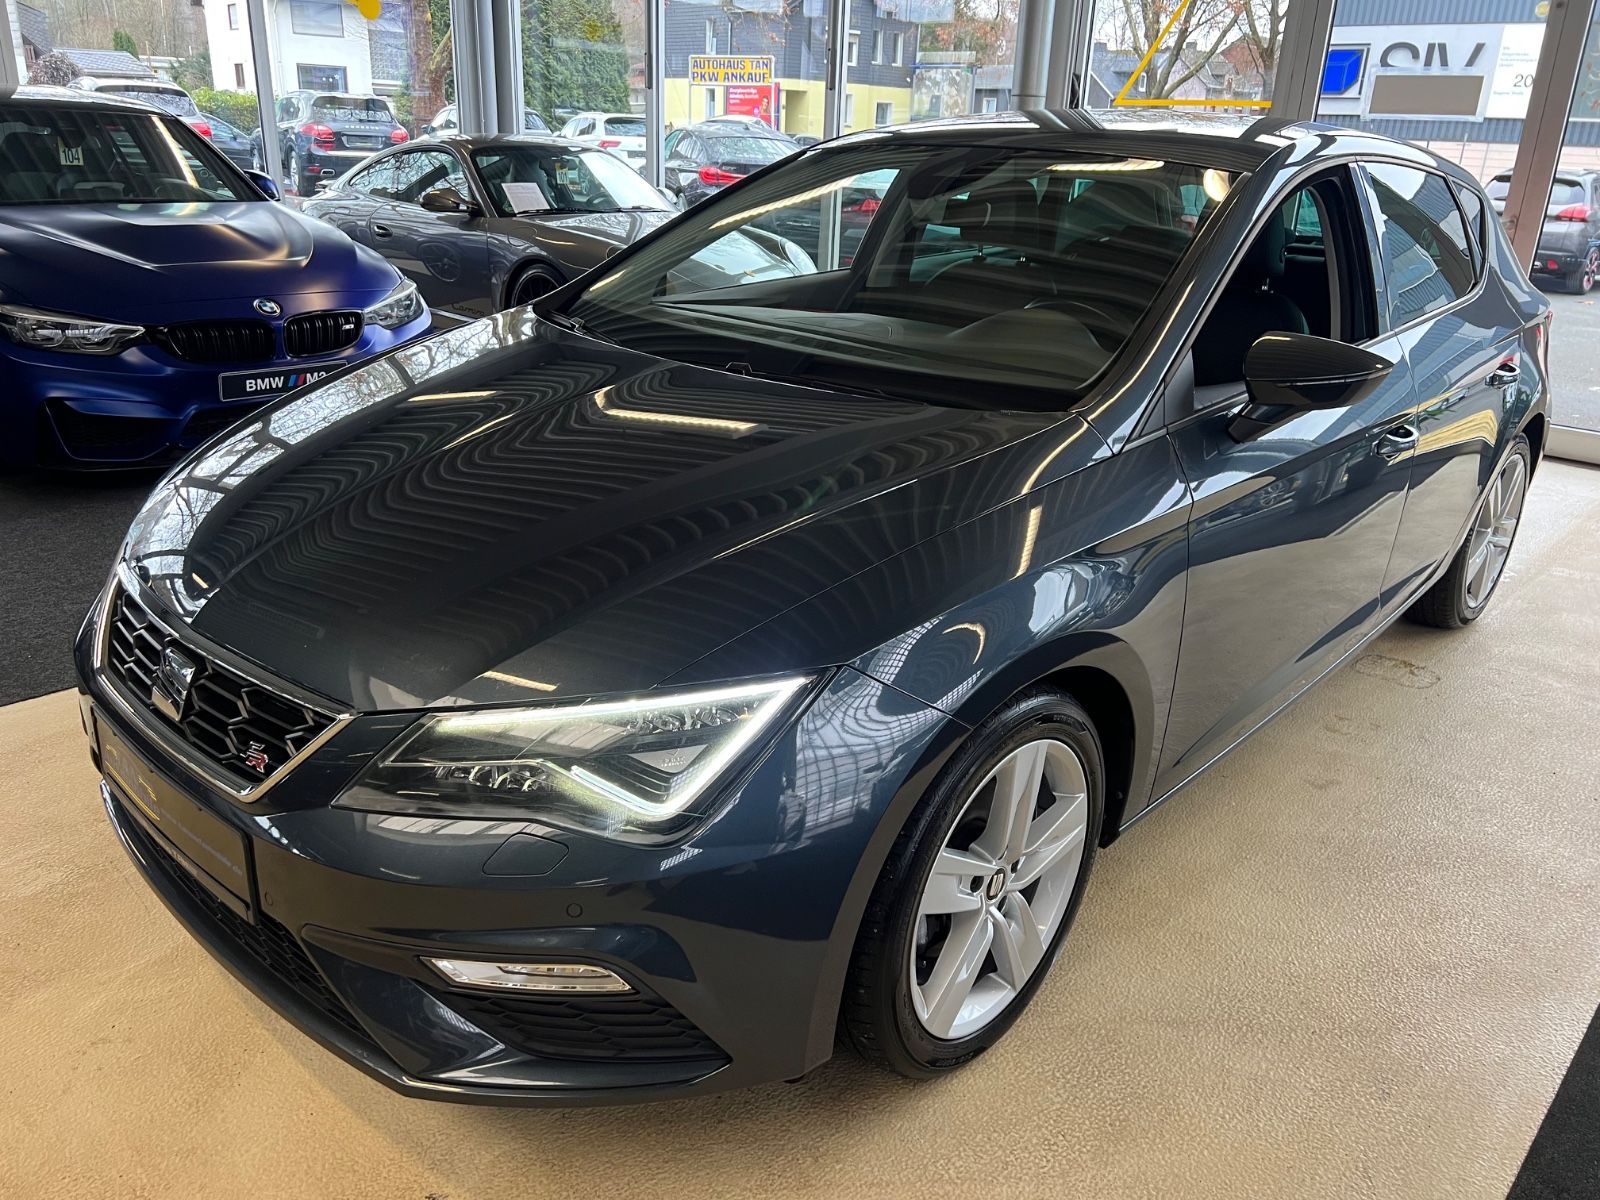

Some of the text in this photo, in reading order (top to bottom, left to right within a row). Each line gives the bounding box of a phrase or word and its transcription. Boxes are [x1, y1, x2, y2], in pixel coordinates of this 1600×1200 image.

[692, 60, 769, 70] AUTOHAUS TAN
[692, 72, 769, 82] PKW ANKAUF
[62, 148, 81, 164] 104
[246, 376, 284, 392] BMW
